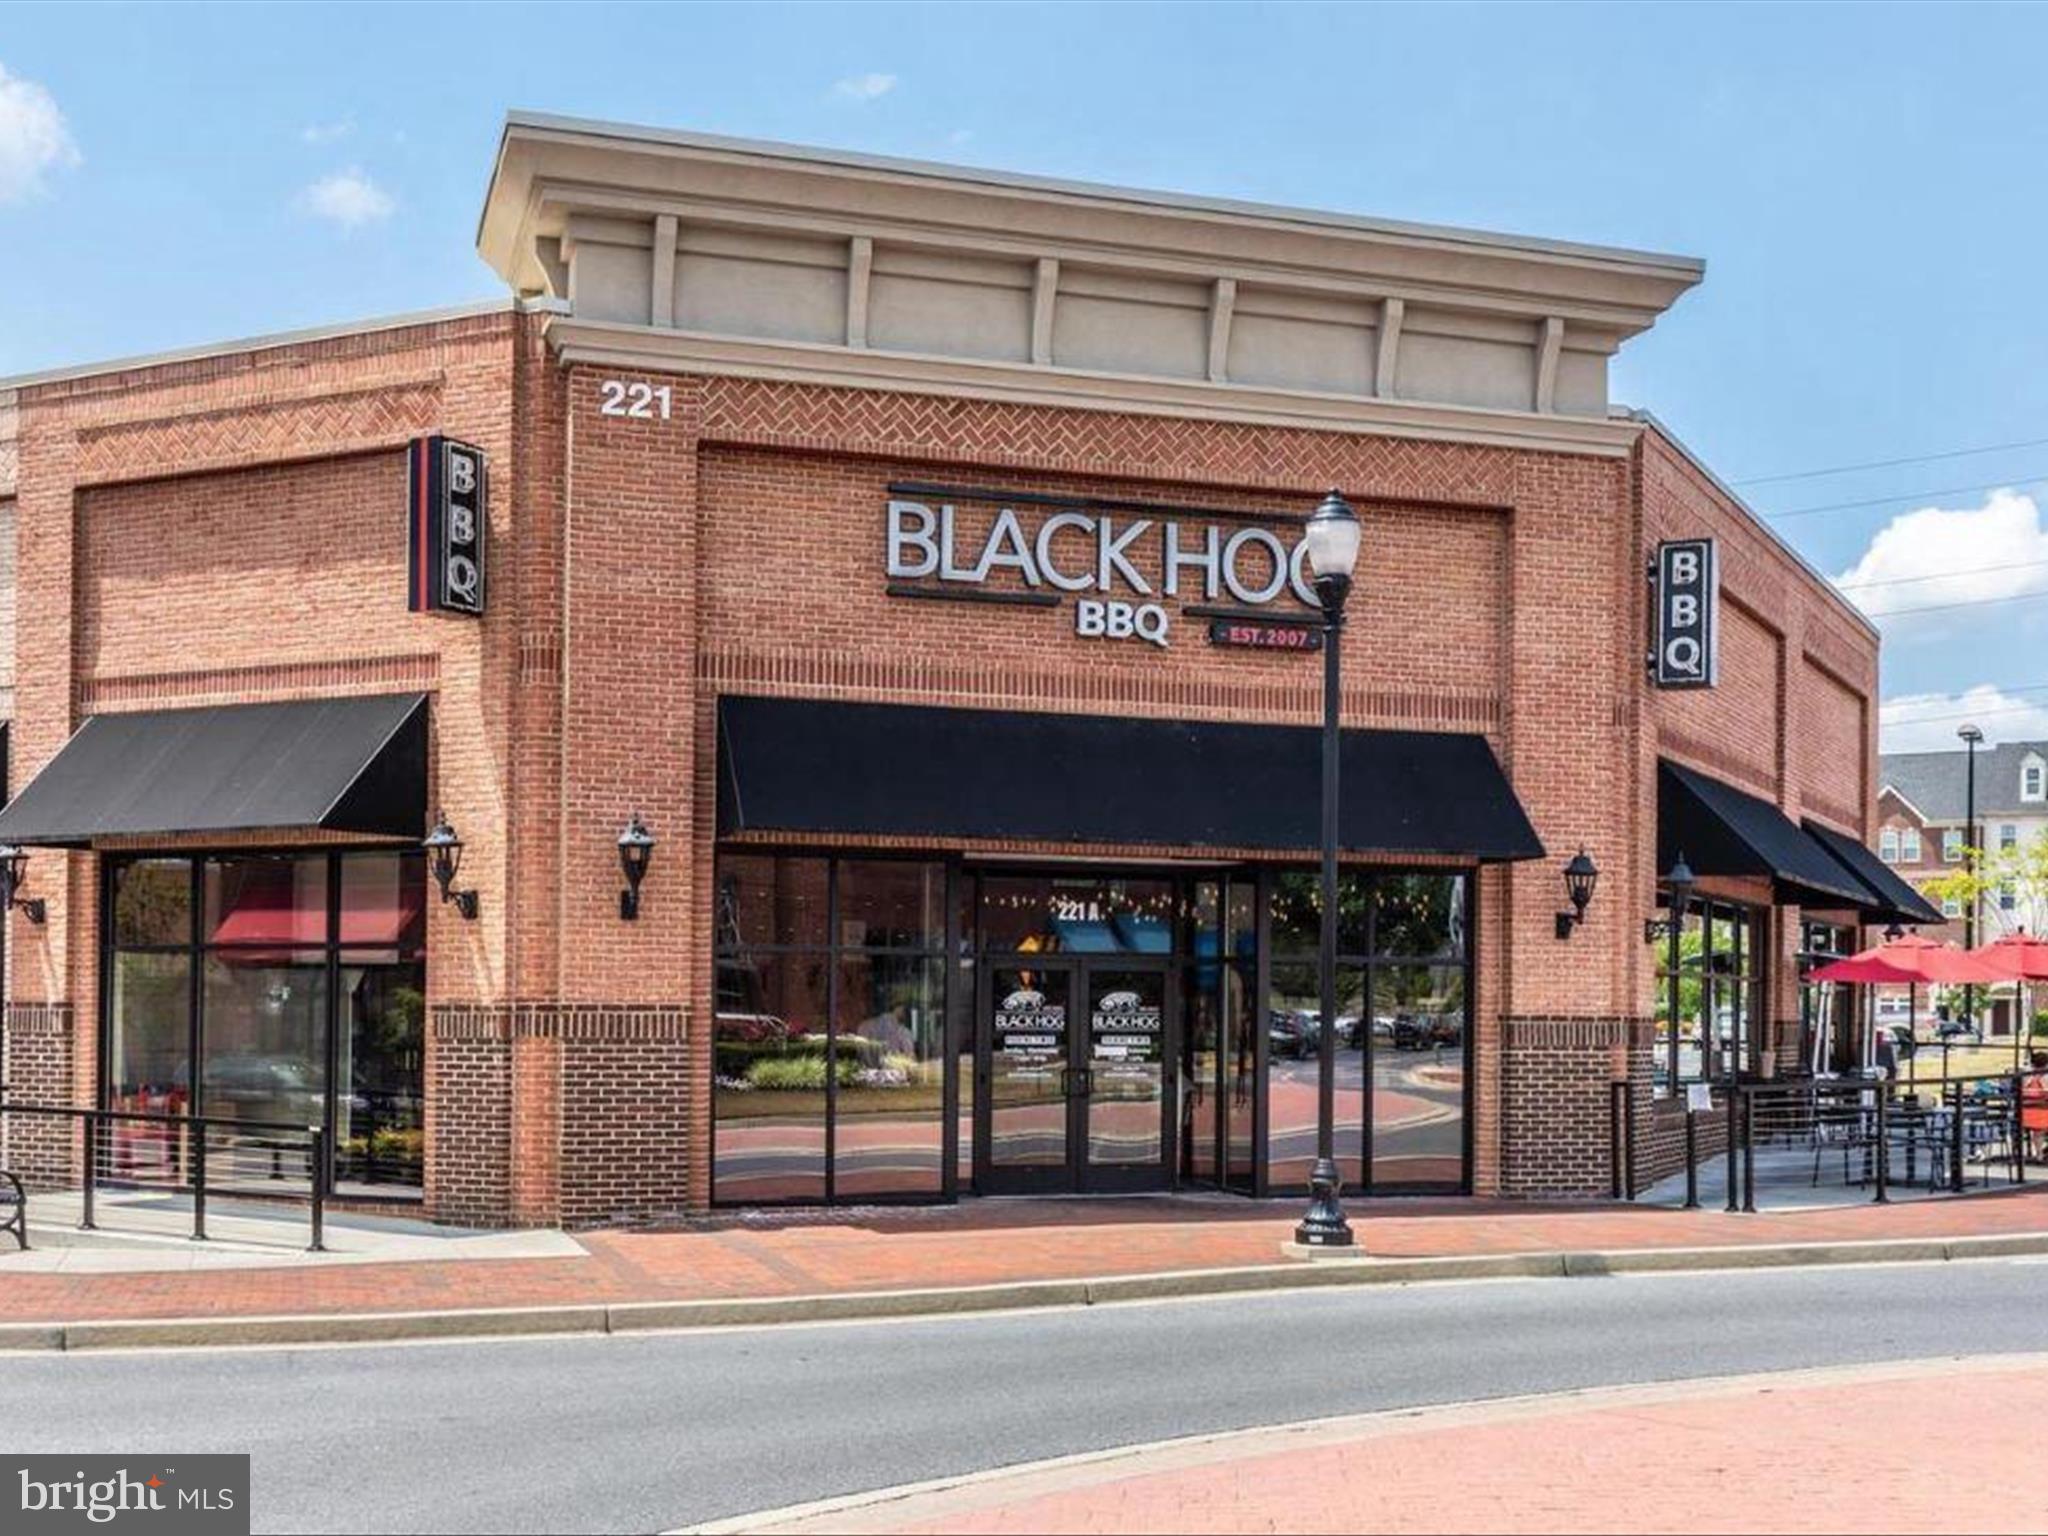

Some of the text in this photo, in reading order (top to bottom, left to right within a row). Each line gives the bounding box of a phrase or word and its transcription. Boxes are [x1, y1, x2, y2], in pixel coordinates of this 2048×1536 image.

[601, 380, 672, 419] 221
[450, 453, 477, 604] BBQ
[887, 499, 1153, 595] BLACK
[1076, 601, 1170, 648] BBQ
[1666, 551, 1700, 675] BBQ
[1230, 627, 1307, 647] EST. 2007
[1058, 900, 1100, 921] 221 A
[995, 1014, 1065, 1030] BLACK HOG
[1092, 1014, 1160, 1030] BLACK HOG
